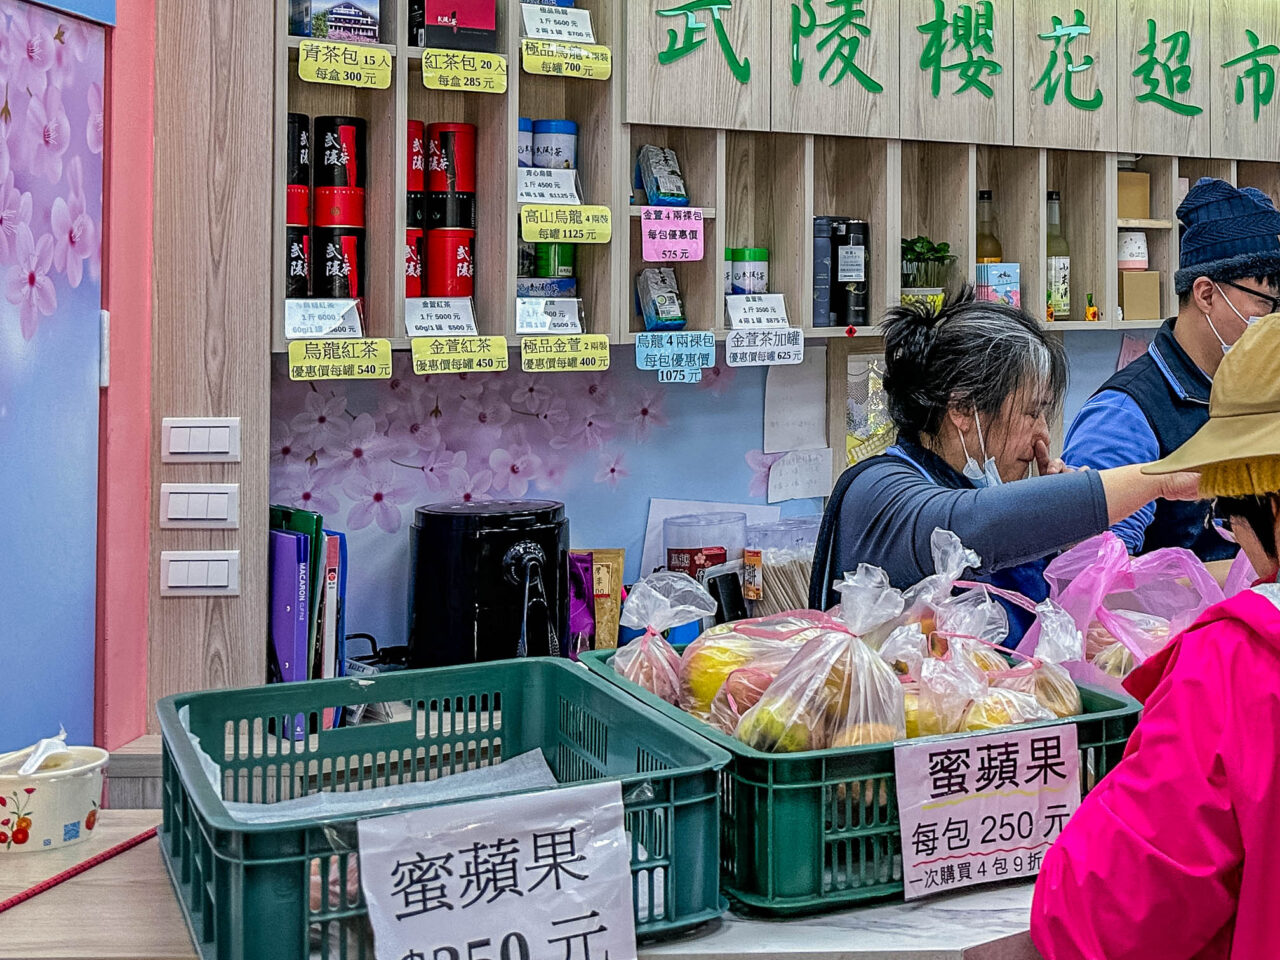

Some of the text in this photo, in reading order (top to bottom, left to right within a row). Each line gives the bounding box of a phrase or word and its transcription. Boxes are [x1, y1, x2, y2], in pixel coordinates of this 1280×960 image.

[303, 44, 375, 65] 青茶包 15
[425, 52, 492, 71] 紅茶包 20
[316, 67, 376, 84] 每盒 300 元
[542, 62, 593, 76] 每罐 700 元
[438, 75, 494, 88] 每盒 285 元
[525, 210, 583, 224] 高山烏龍
[643, 210, 663, 220] 金萱
[539, 228, 596, 240] 每罐 1125 元
[648, 229, 698, 240] 每包優惠價
[680, 250, 689, 259] 元
[430, 338, 490, 354] 金萱紅茶
[523, 338, 581, 354] 極品金萱
[637, 334, 663, 348] 烏龍
[667, 335, 672, 346] 4
[731, 331, 800, 348] 金萱茶加罐
[304, 341, 378, 360] 烏龍紅茶
[729, 353, 775, 363] 優惠價每罐
[793, 351, 801, 361] 元
[416, 358, 506, 371] 優惠價每罐 450 元
[524, 356, 608, 370] 優惠價每罐 400 元
[644, 353, 710, 368] 每包優惠價
[292, 364, 390, 378] 優惠價每罐 540 元
[660, 369, 700, 382] 1075 元
[929, 735, 1067, 799] 蜜蘋果
[912, 804, 1070, 856] 每包 250 元
[391, 827, 589, 922] 蜜蘋果
[909, 851, 1043, 888] 一次購買 4 包 9 折
